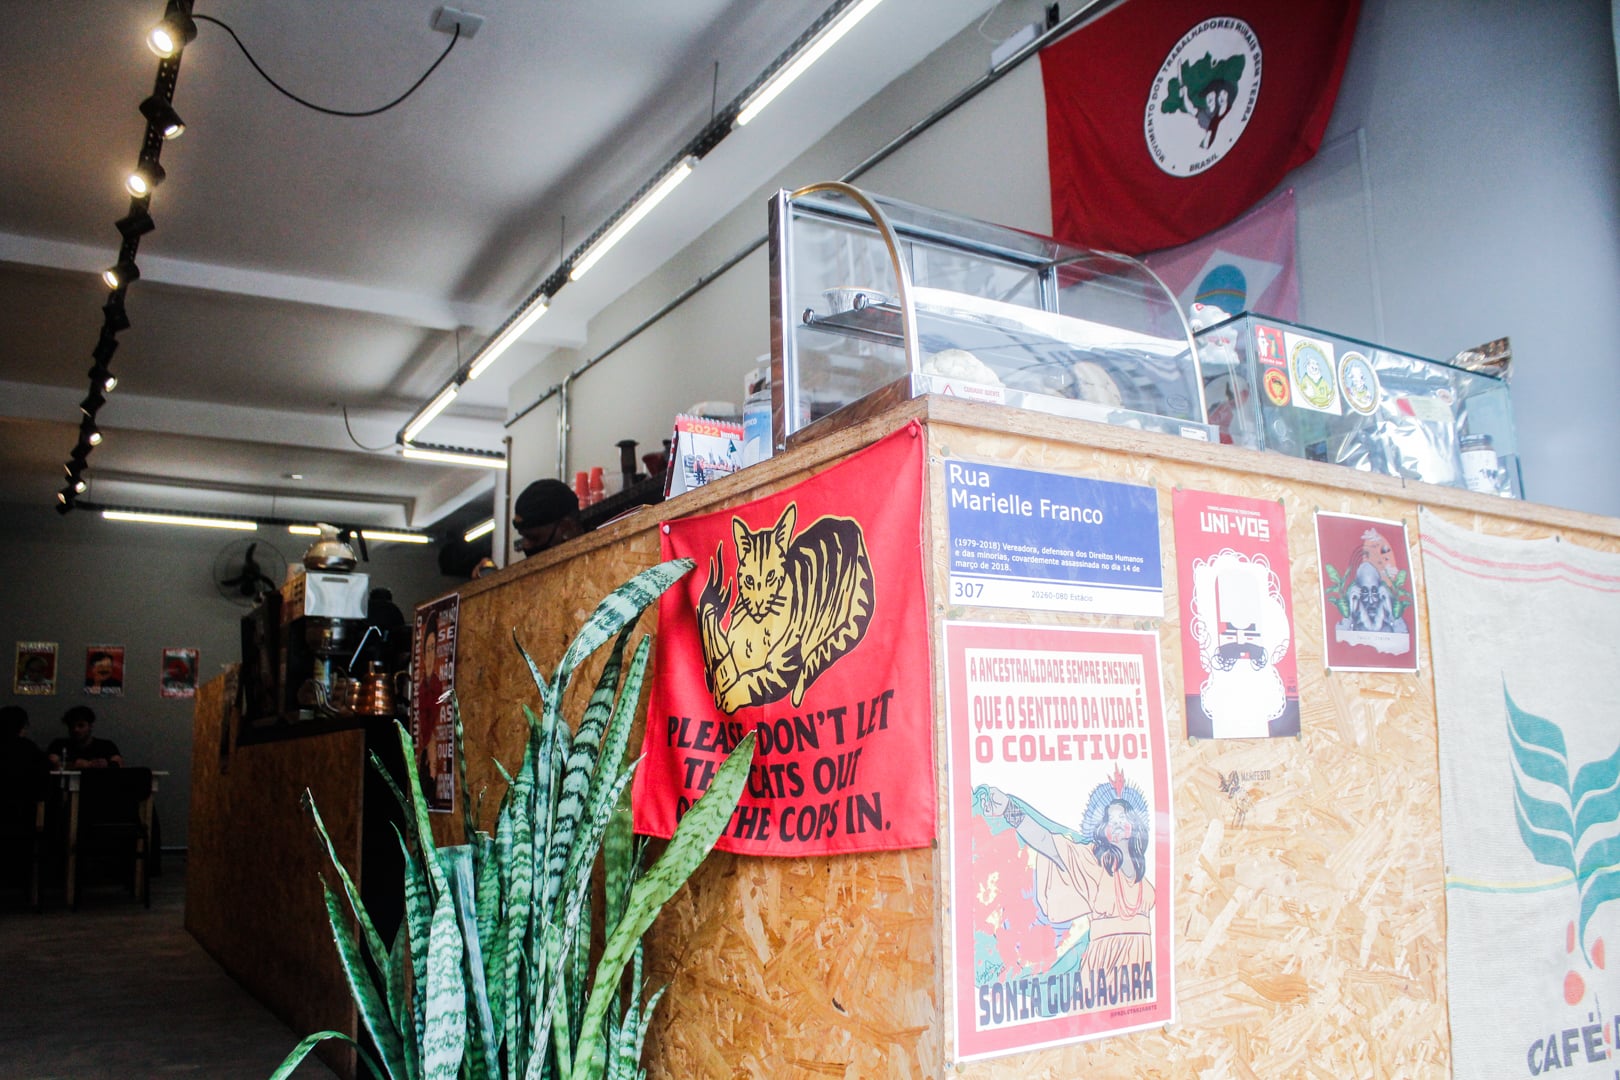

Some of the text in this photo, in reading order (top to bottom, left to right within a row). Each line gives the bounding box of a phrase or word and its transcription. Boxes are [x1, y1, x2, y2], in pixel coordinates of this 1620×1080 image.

[1147, 19, 1261, 163] MOVIMENTO DOS TRABALHADORES RURAIS SEM TERRA
[1189, 153, 1219, 173] BRASIL
[687, 423, 719, 436] 2022
[950, 464, 990, 488] Rua
[951, 488, 1103, 525] Marielle Franco
[955, 537, 1143, 564] (1979-2018) Vereadora, defensora dos Direitos Humanos
[962, 549, 975, 558] das
[977, 551, 1010, 563] minorias,
[1012, 555, 1059, 566] covardemente
[1061, 559, 1100, 569] assassinada
[1101, 562, 1109, 570] no
[1111, 562, 1120, 571] dia
[1123, 564, 1131, 572] 14
[1132, 565, 1140, 573] de
[955, 561, 1012, 572] março de 2018.
[954, 582, 984, 599] 307
[1070, 593, 1093, 602] Estácio
[438, 626, 454, 642] SE
[970, 657, 1141, 686] A ANCESTRALIDADE SEMPRE ENSINOU
[439, 705, 453, 724] AS
[757, 706, 846, 756] DON'T
[856, 689, 894, 740] LET
[974, 688, 1144, 733] QUE O SENTIDO DA VIDA É
[975, 733, 1148, 763] O COLETIVO!
[684, 748, 863, 799] TH CATS OUT
[779, 800, 839, 842] COPS
[846, 792, 891, 835] IN.
[979, 977, 1042, 1026] SONIA
[1047, 961, 1154, 1015] GUAJAJARA
[1527, 1012, 1607, 1076] CAFÉ
